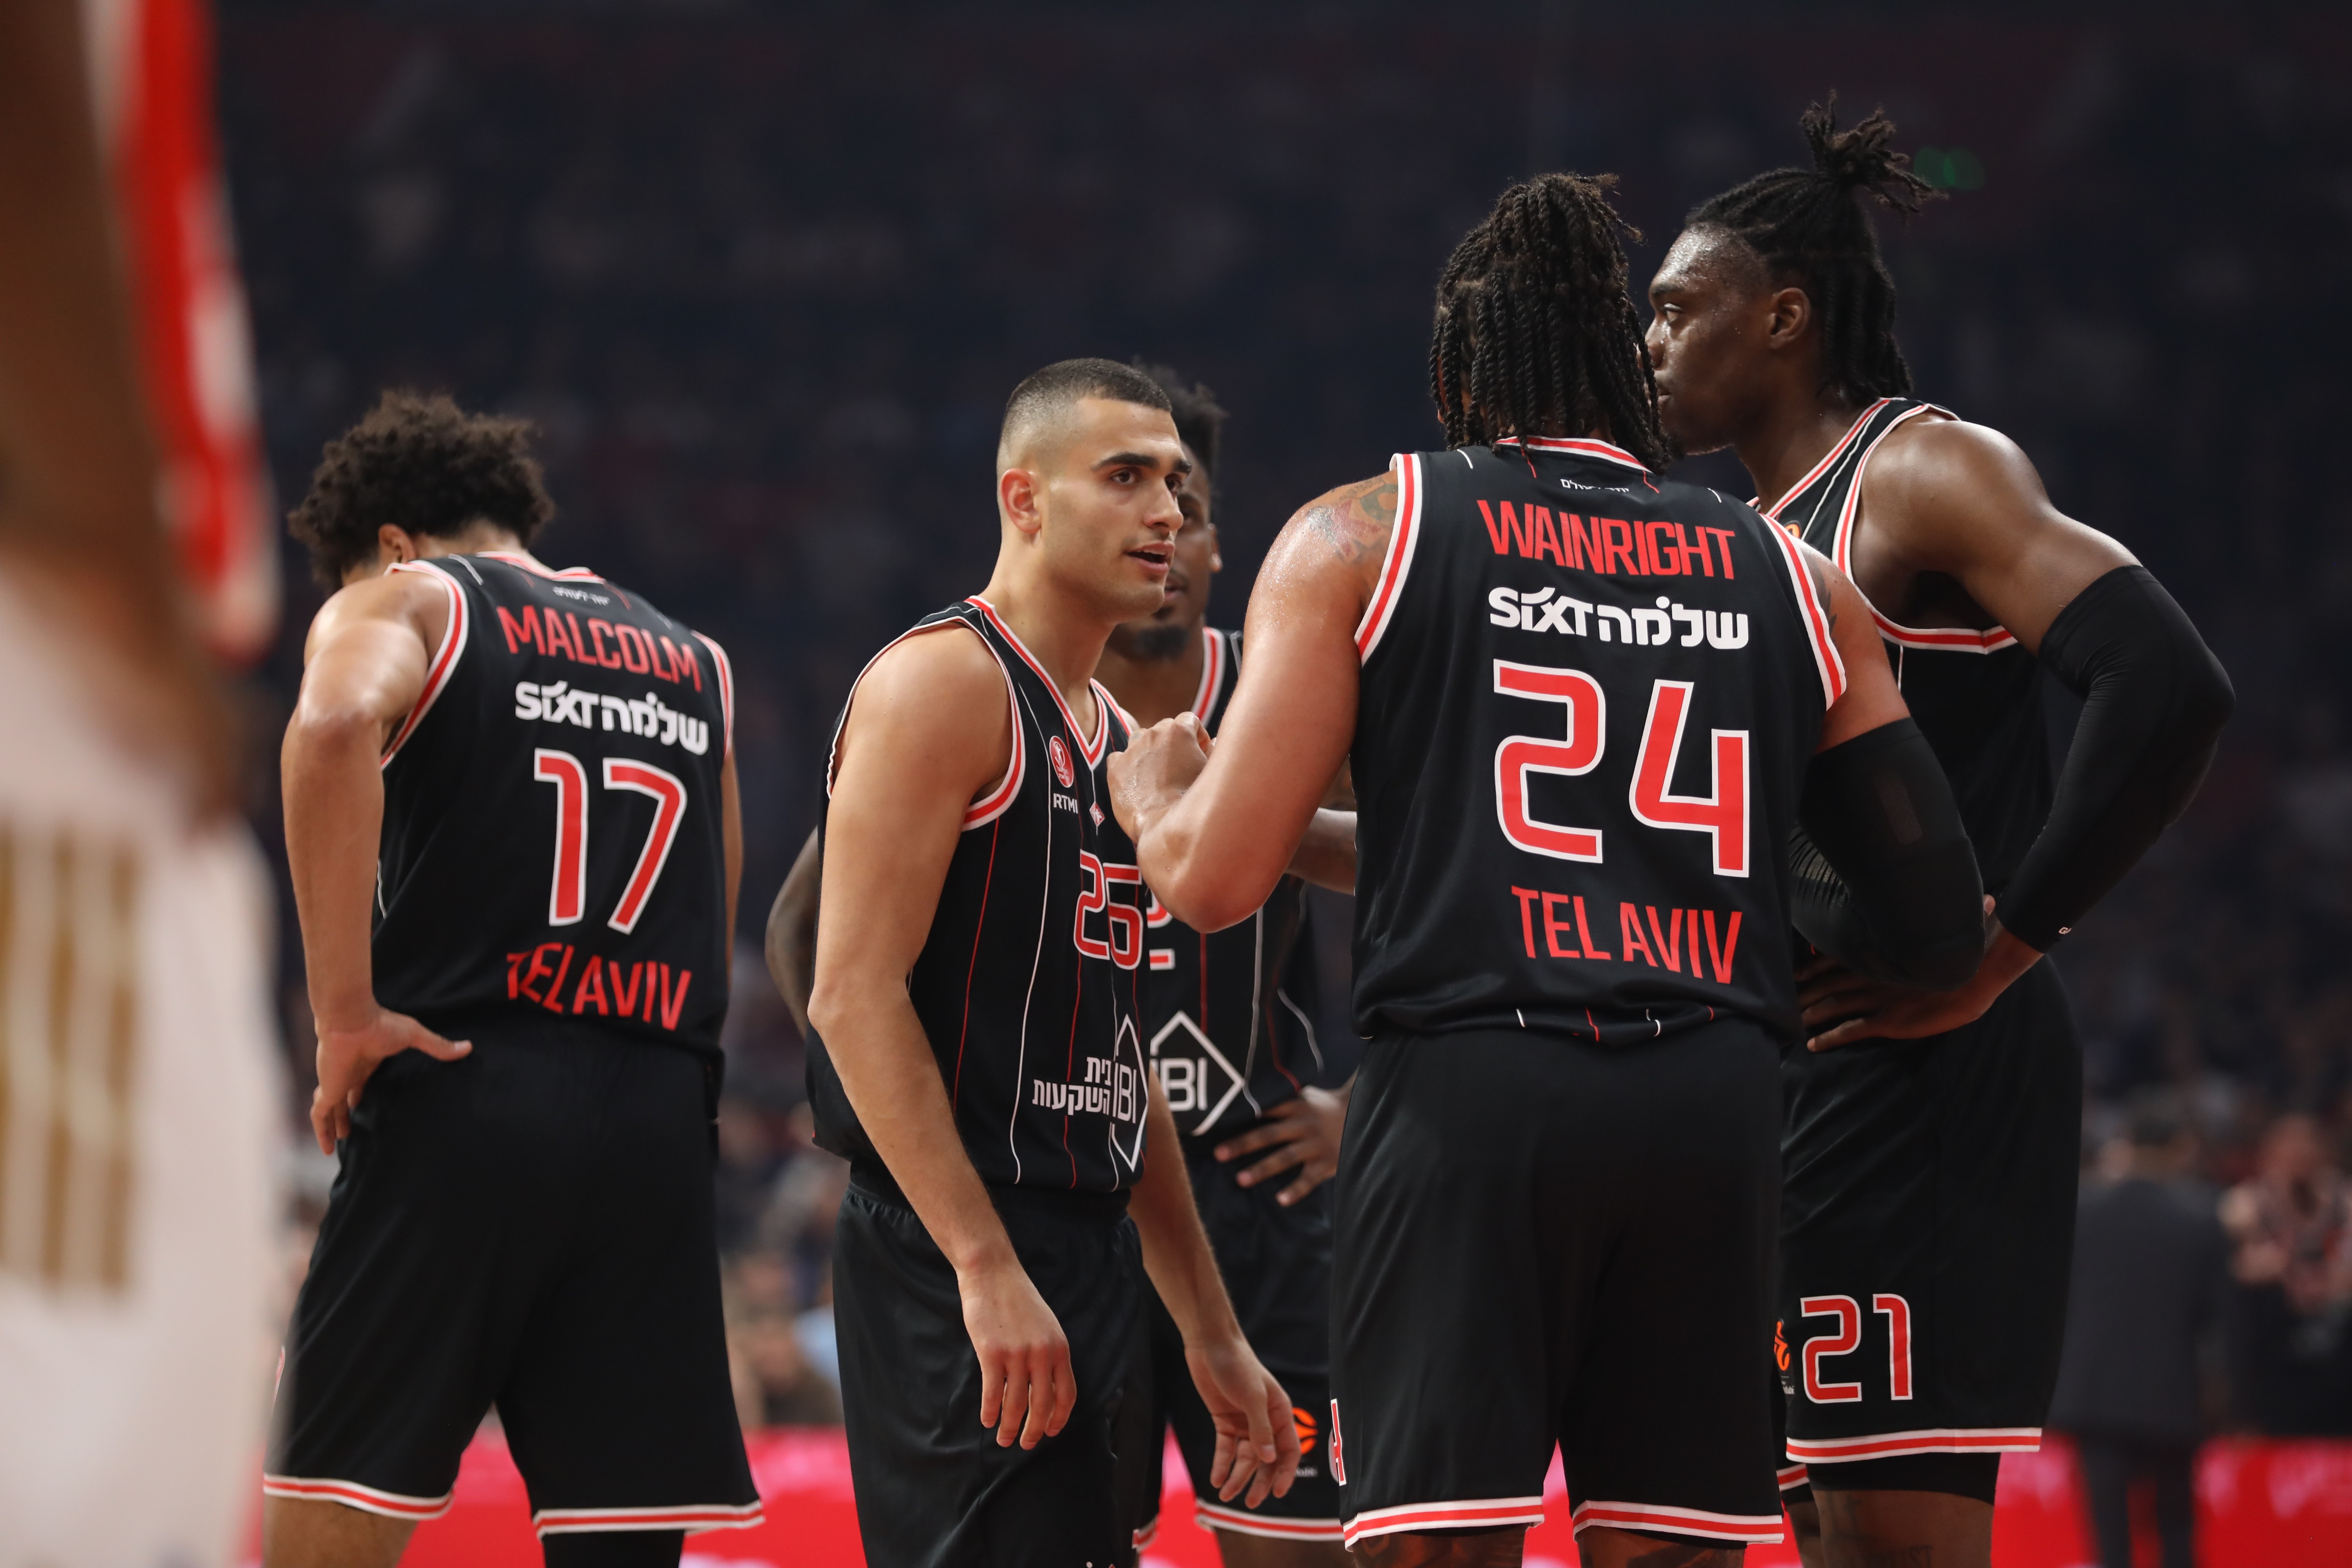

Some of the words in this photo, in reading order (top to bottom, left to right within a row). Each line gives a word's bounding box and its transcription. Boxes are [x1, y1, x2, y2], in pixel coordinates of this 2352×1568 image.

[1477, 500, 1735, 580] WAINRIGHT
[497, 605, 702, 693] MALCOLM
[1053, 793, 1078, 814] RTMI
[1493, 658, 1749, 878] 24
[534, 748, 687, 935] 17
[1512, 885, 1611, 959] TEL
[1619, 902, 1743, 984] AVIV
[507, 942, 574, 1013] TEL
[572, 955, 692, 1031] AVIV
[1032, 1079, 1110, 1116] השקעות
[1113, 1063, 1136, 1124] IBI
[1800, 1293, 1913, 1404] 21
